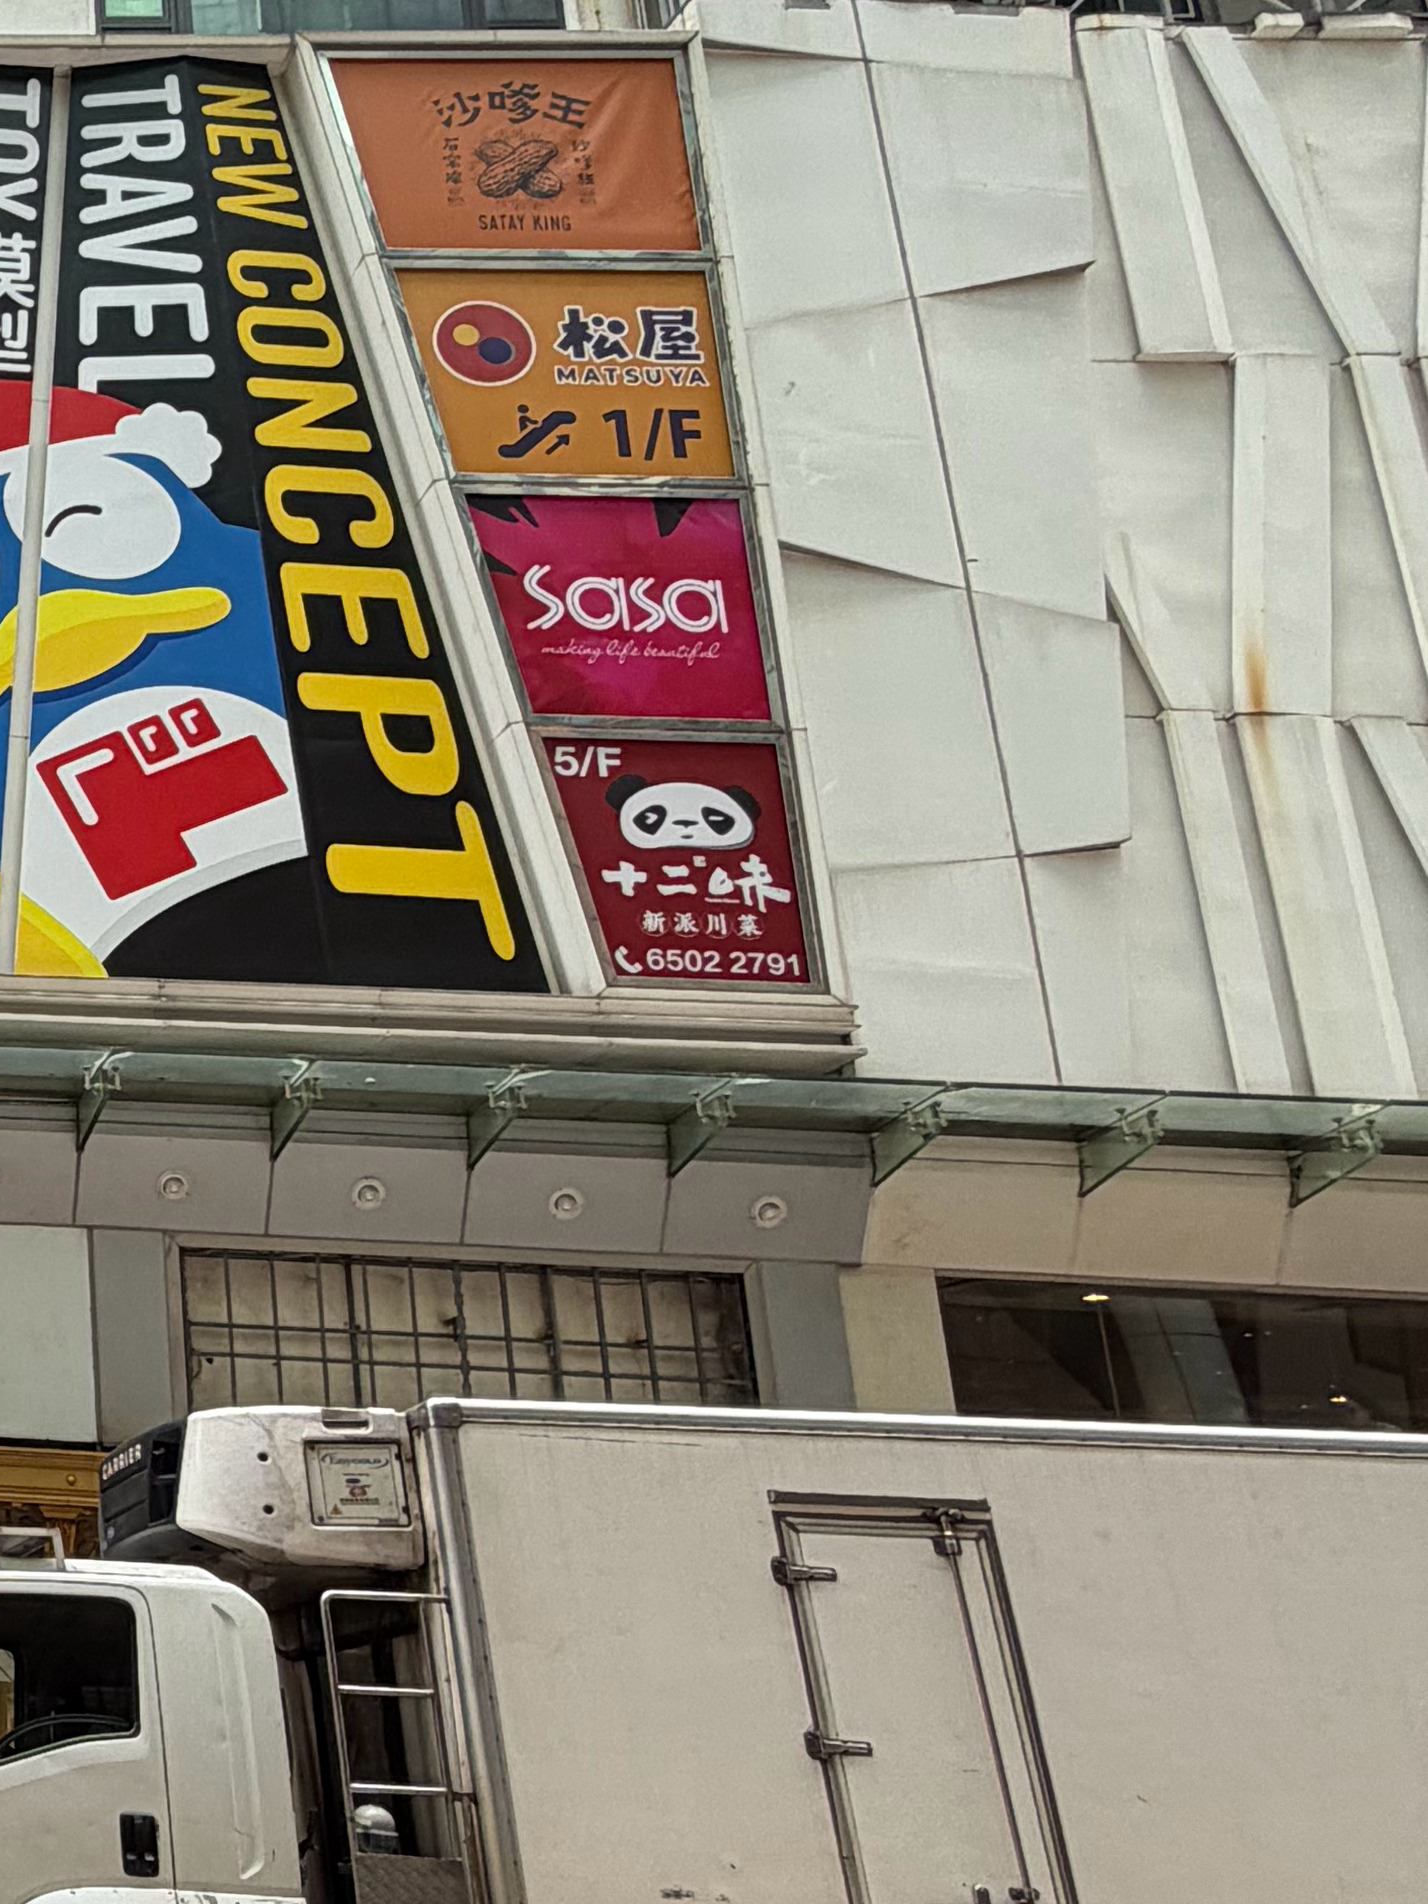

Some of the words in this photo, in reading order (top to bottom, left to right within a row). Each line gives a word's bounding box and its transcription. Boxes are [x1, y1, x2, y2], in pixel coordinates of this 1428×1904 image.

[196, 82, 310, 231] NEW
[77, 74, 216, 398] TRAVEL
[478, 214, 526, 232] SATAY
[532, 214, 573, 232] KING
[554, 305, 705, 364] 松屋
[554, 364, 710, 387] MATSUYA
[601, 407, 702, 461] 1/F
[226, 248, 517, 963] CONCEPT
[541, 640, 604, 665] making
[605, 638, 641, 665] life
[643, 639, 722, 667] beautiful
[553, 745, 622, 778] 5/F
[642, 909, 764, 939] 新派川菜
[645, 948, 729, 974] 6502
[730, 951, 802, 977] 2791
